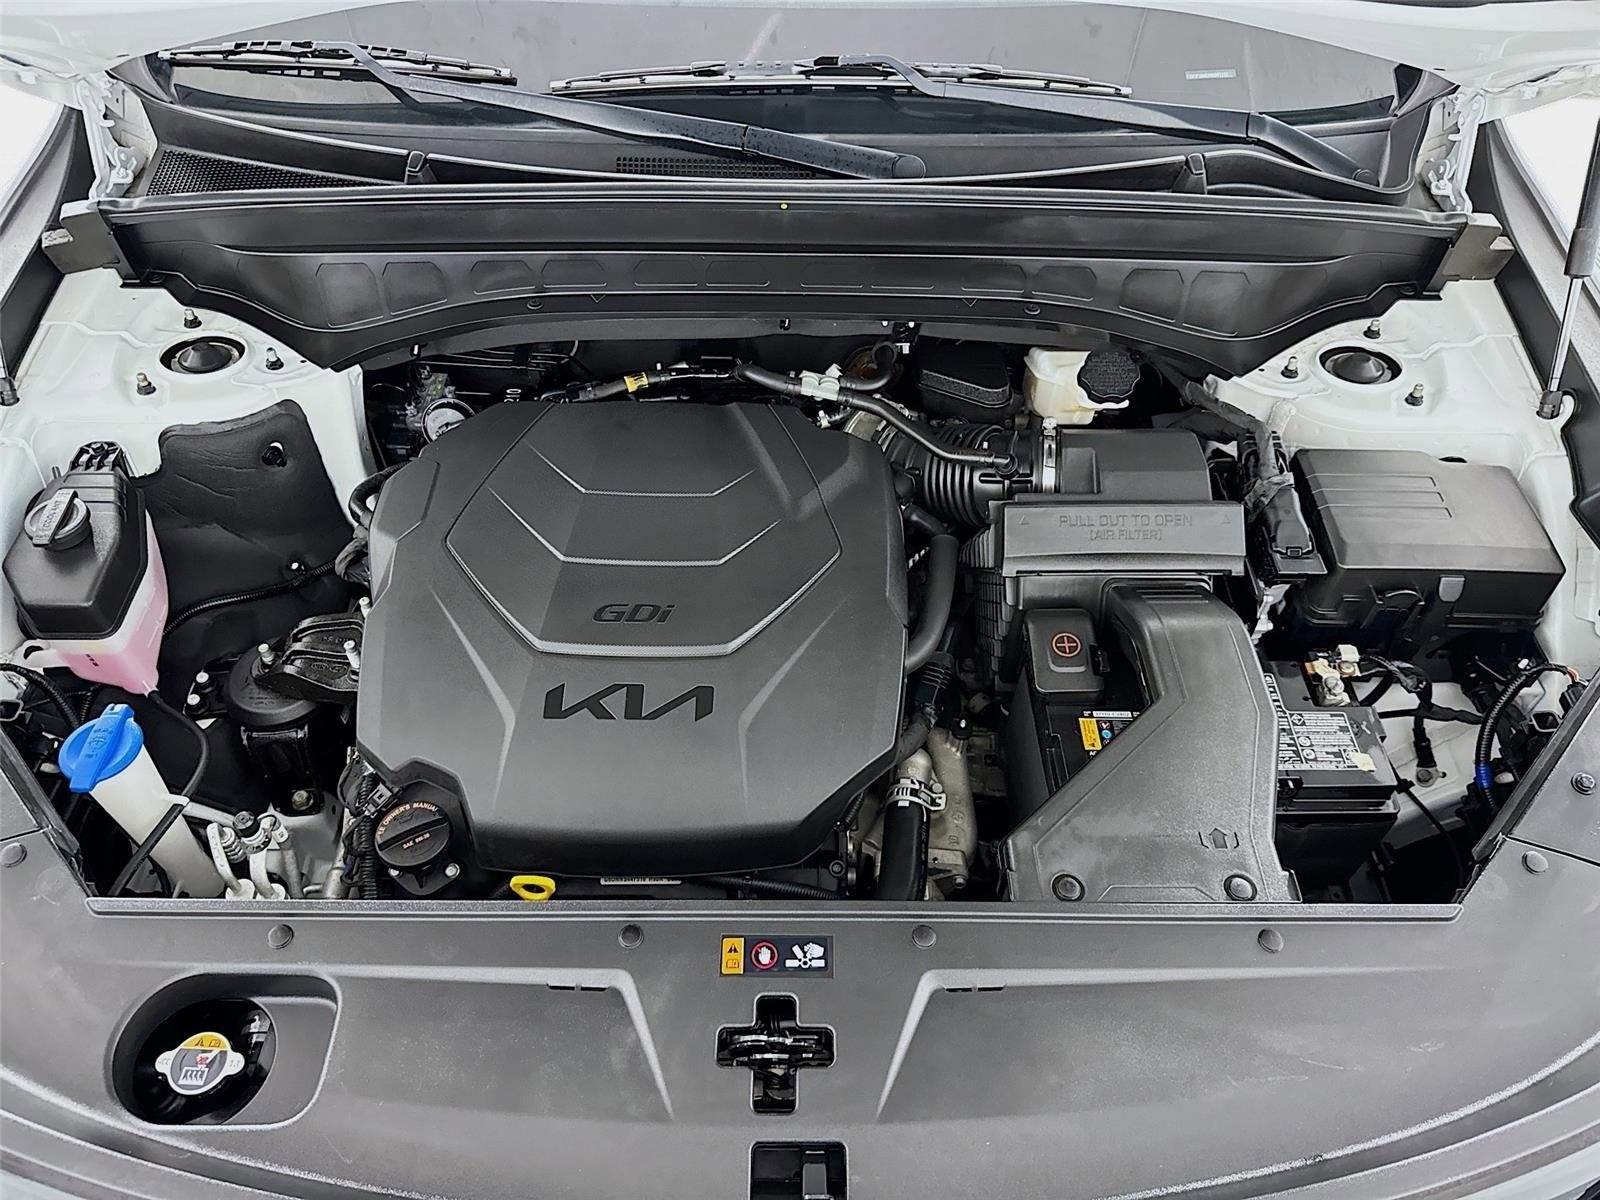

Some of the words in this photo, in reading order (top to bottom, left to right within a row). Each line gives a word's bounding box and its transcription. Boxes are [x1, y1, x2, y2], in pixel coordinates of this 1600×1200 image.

[1058, 513, 1094, 528] PULL
[1097, 513, 1127, 528] OUT
[1130, 513, 1151, 527] TO
[1154, 513, 1193, 528] OPEN
[592, 603, 676, 624] GDi
